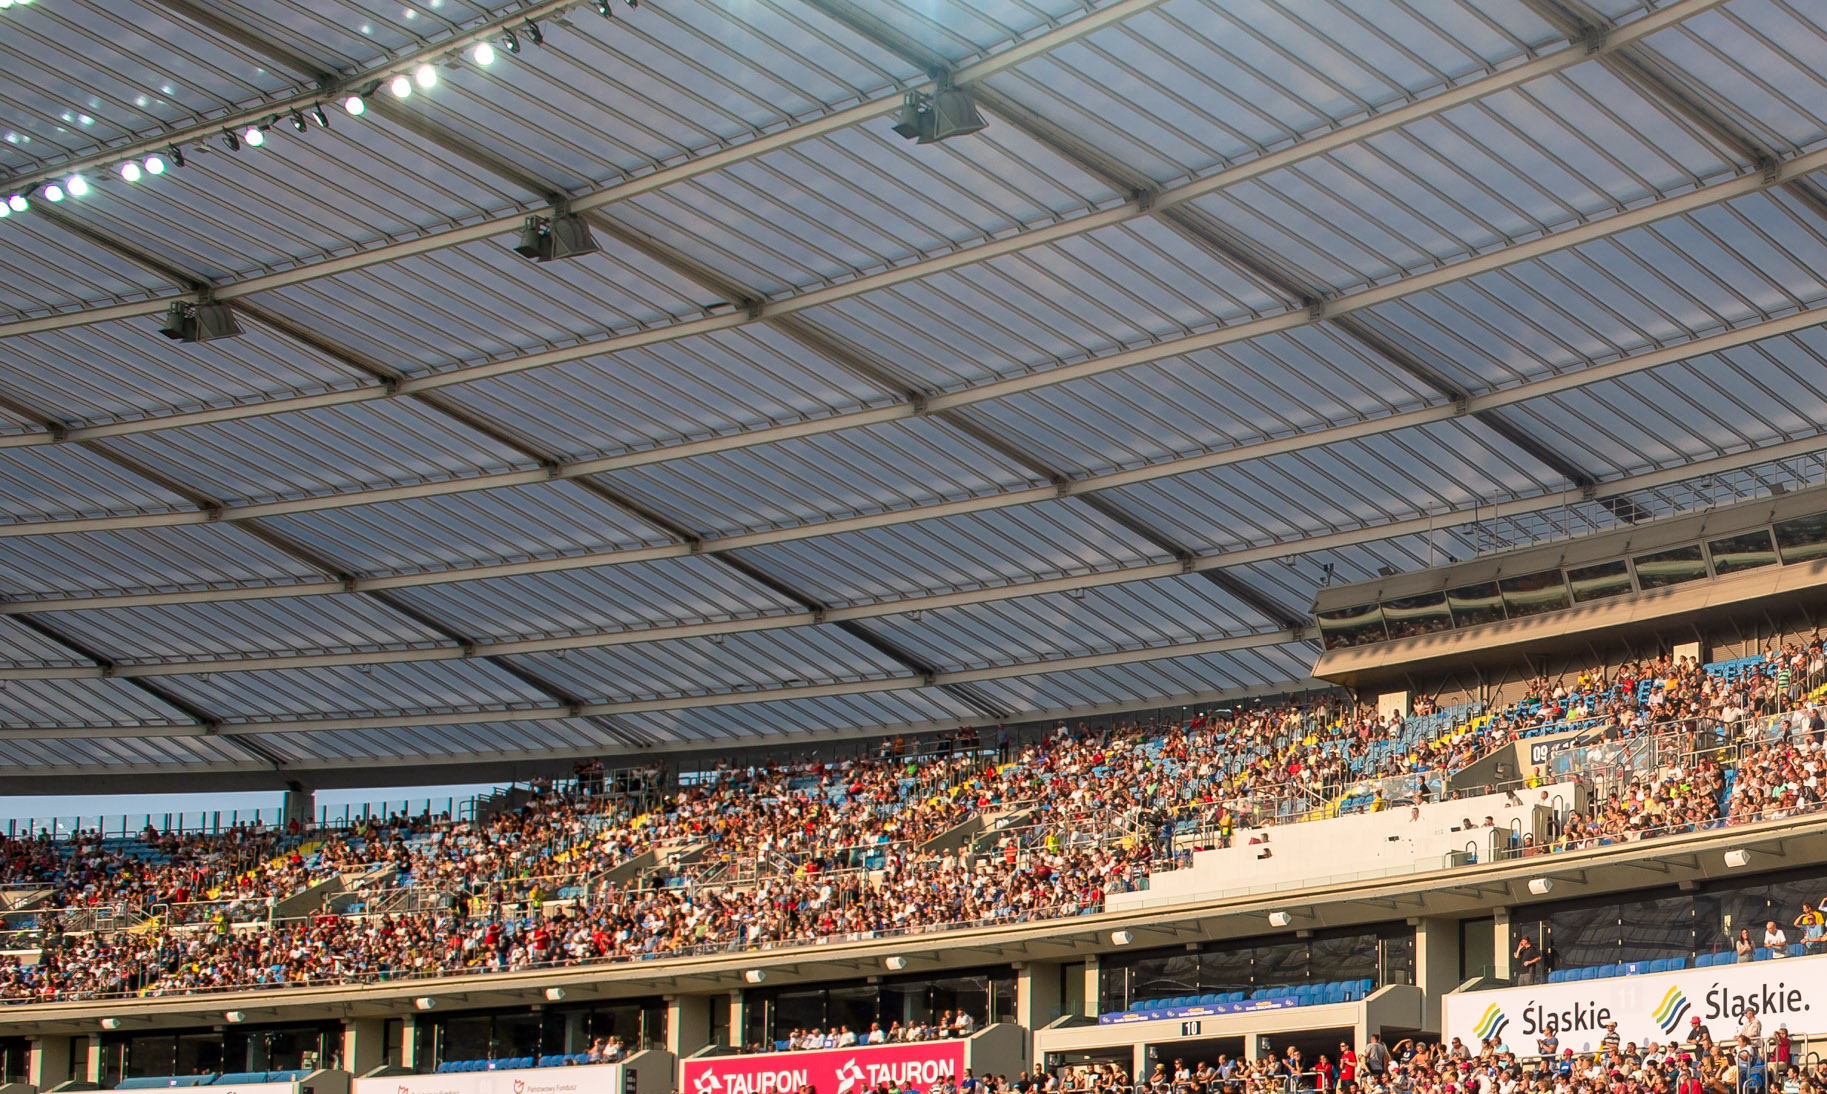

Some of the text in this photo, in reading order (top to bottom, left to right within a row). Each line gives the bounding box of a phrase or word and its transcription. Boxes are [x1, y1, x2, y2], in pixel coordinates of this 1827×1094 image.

[1705, 981, 1810, 1026] Śląskie.
[1185, 1022, 1198, 1035] 10
[866, 1058, 955, 1087] TAURON
